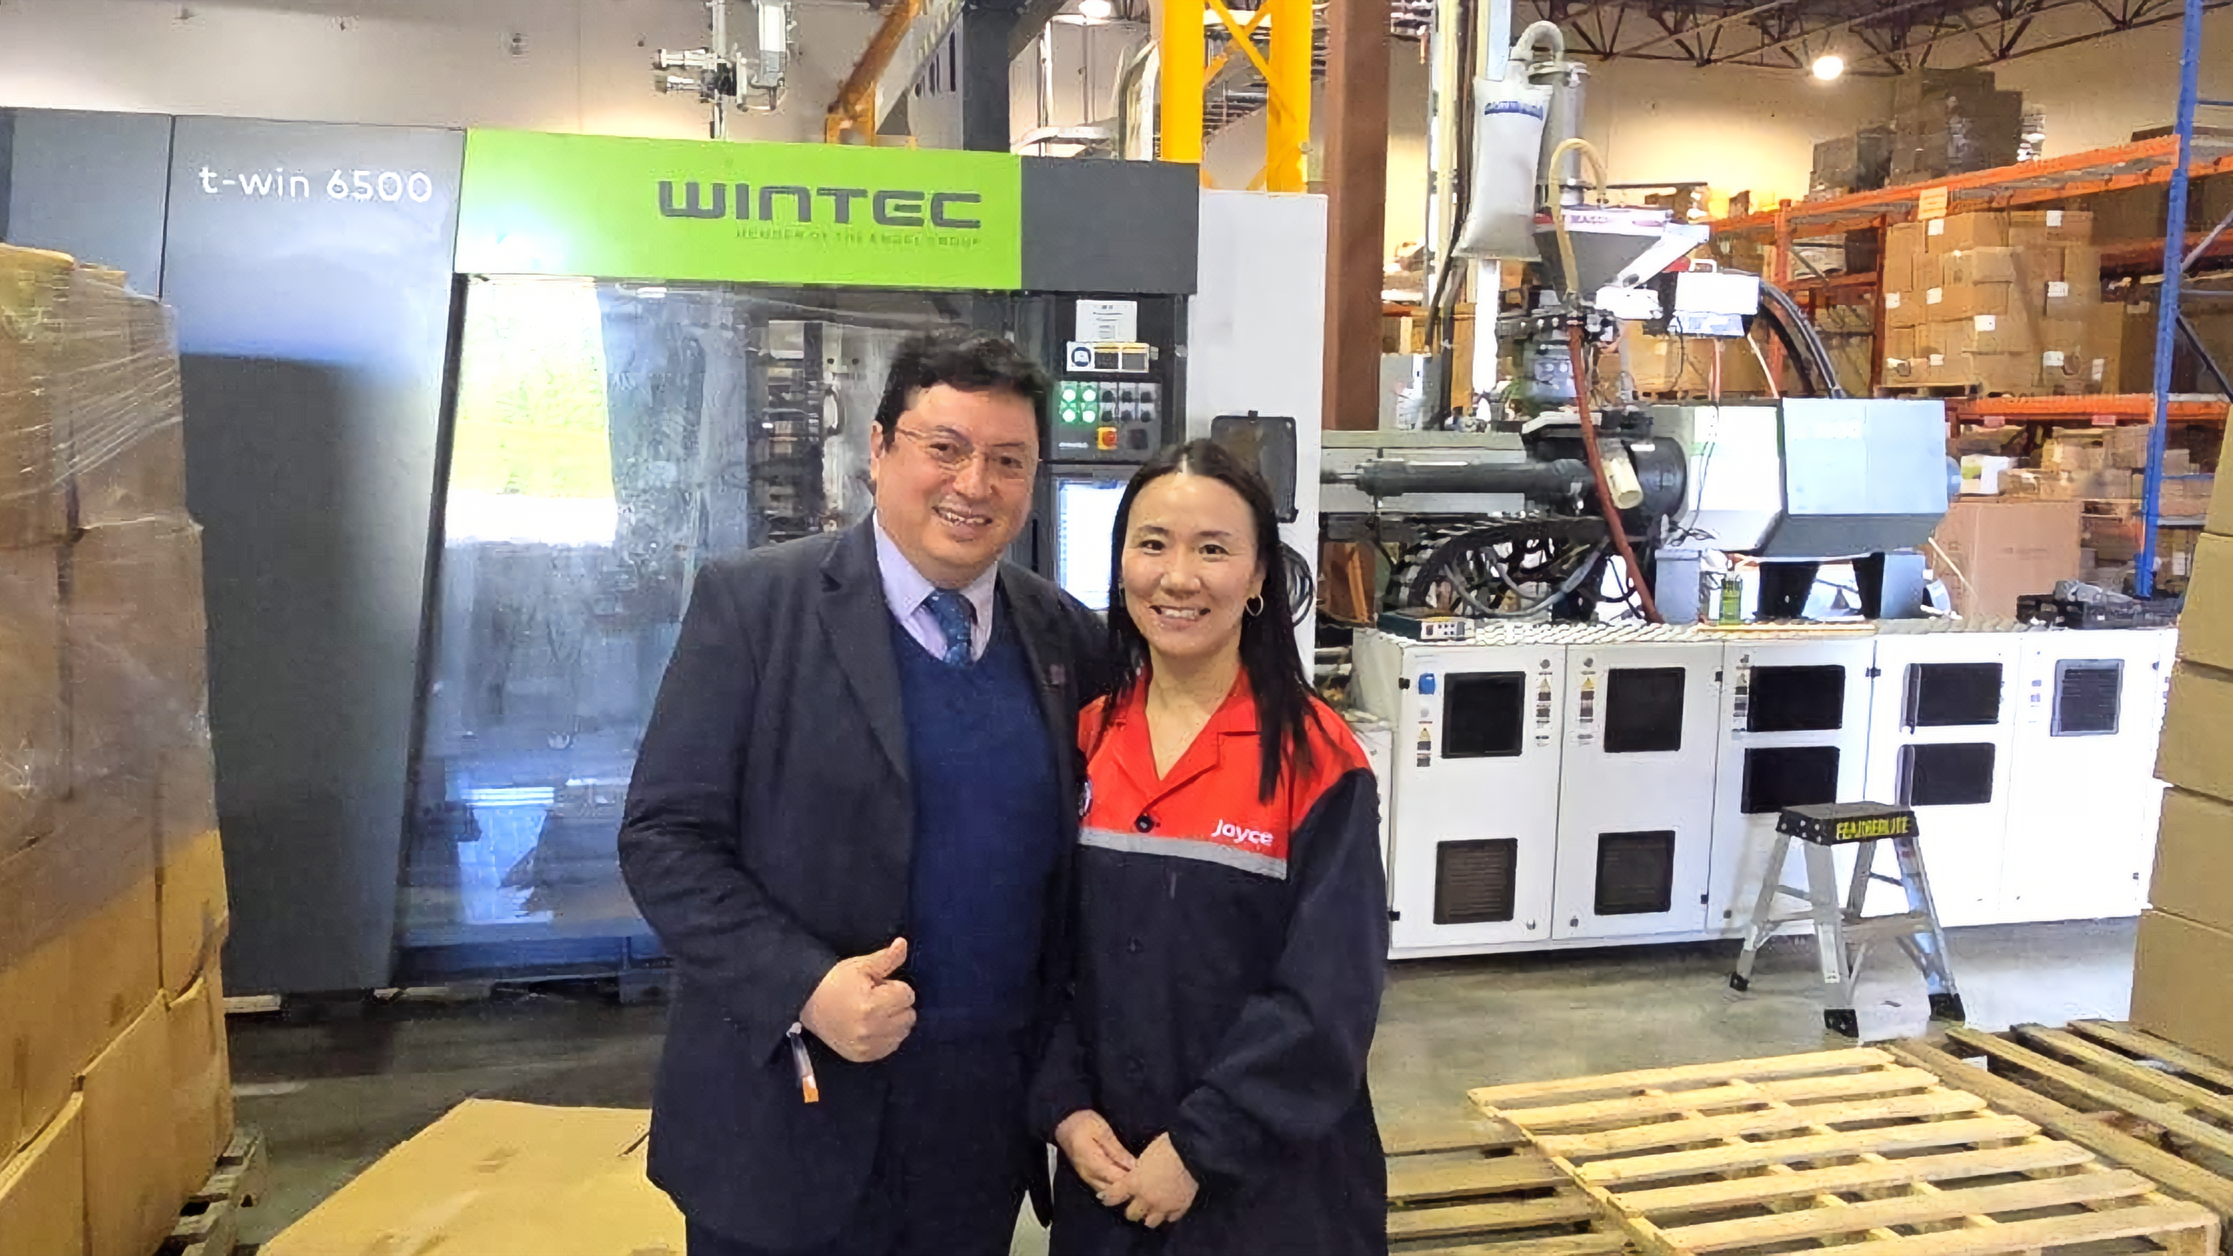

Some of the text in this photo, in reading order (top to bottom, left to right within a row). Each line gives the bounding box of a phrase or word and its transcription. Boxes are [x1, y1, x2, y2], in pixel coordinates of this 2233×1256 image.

[198, 165, 433, 203] t-win 6500
[658, 180, 982, 229] WINTEC
